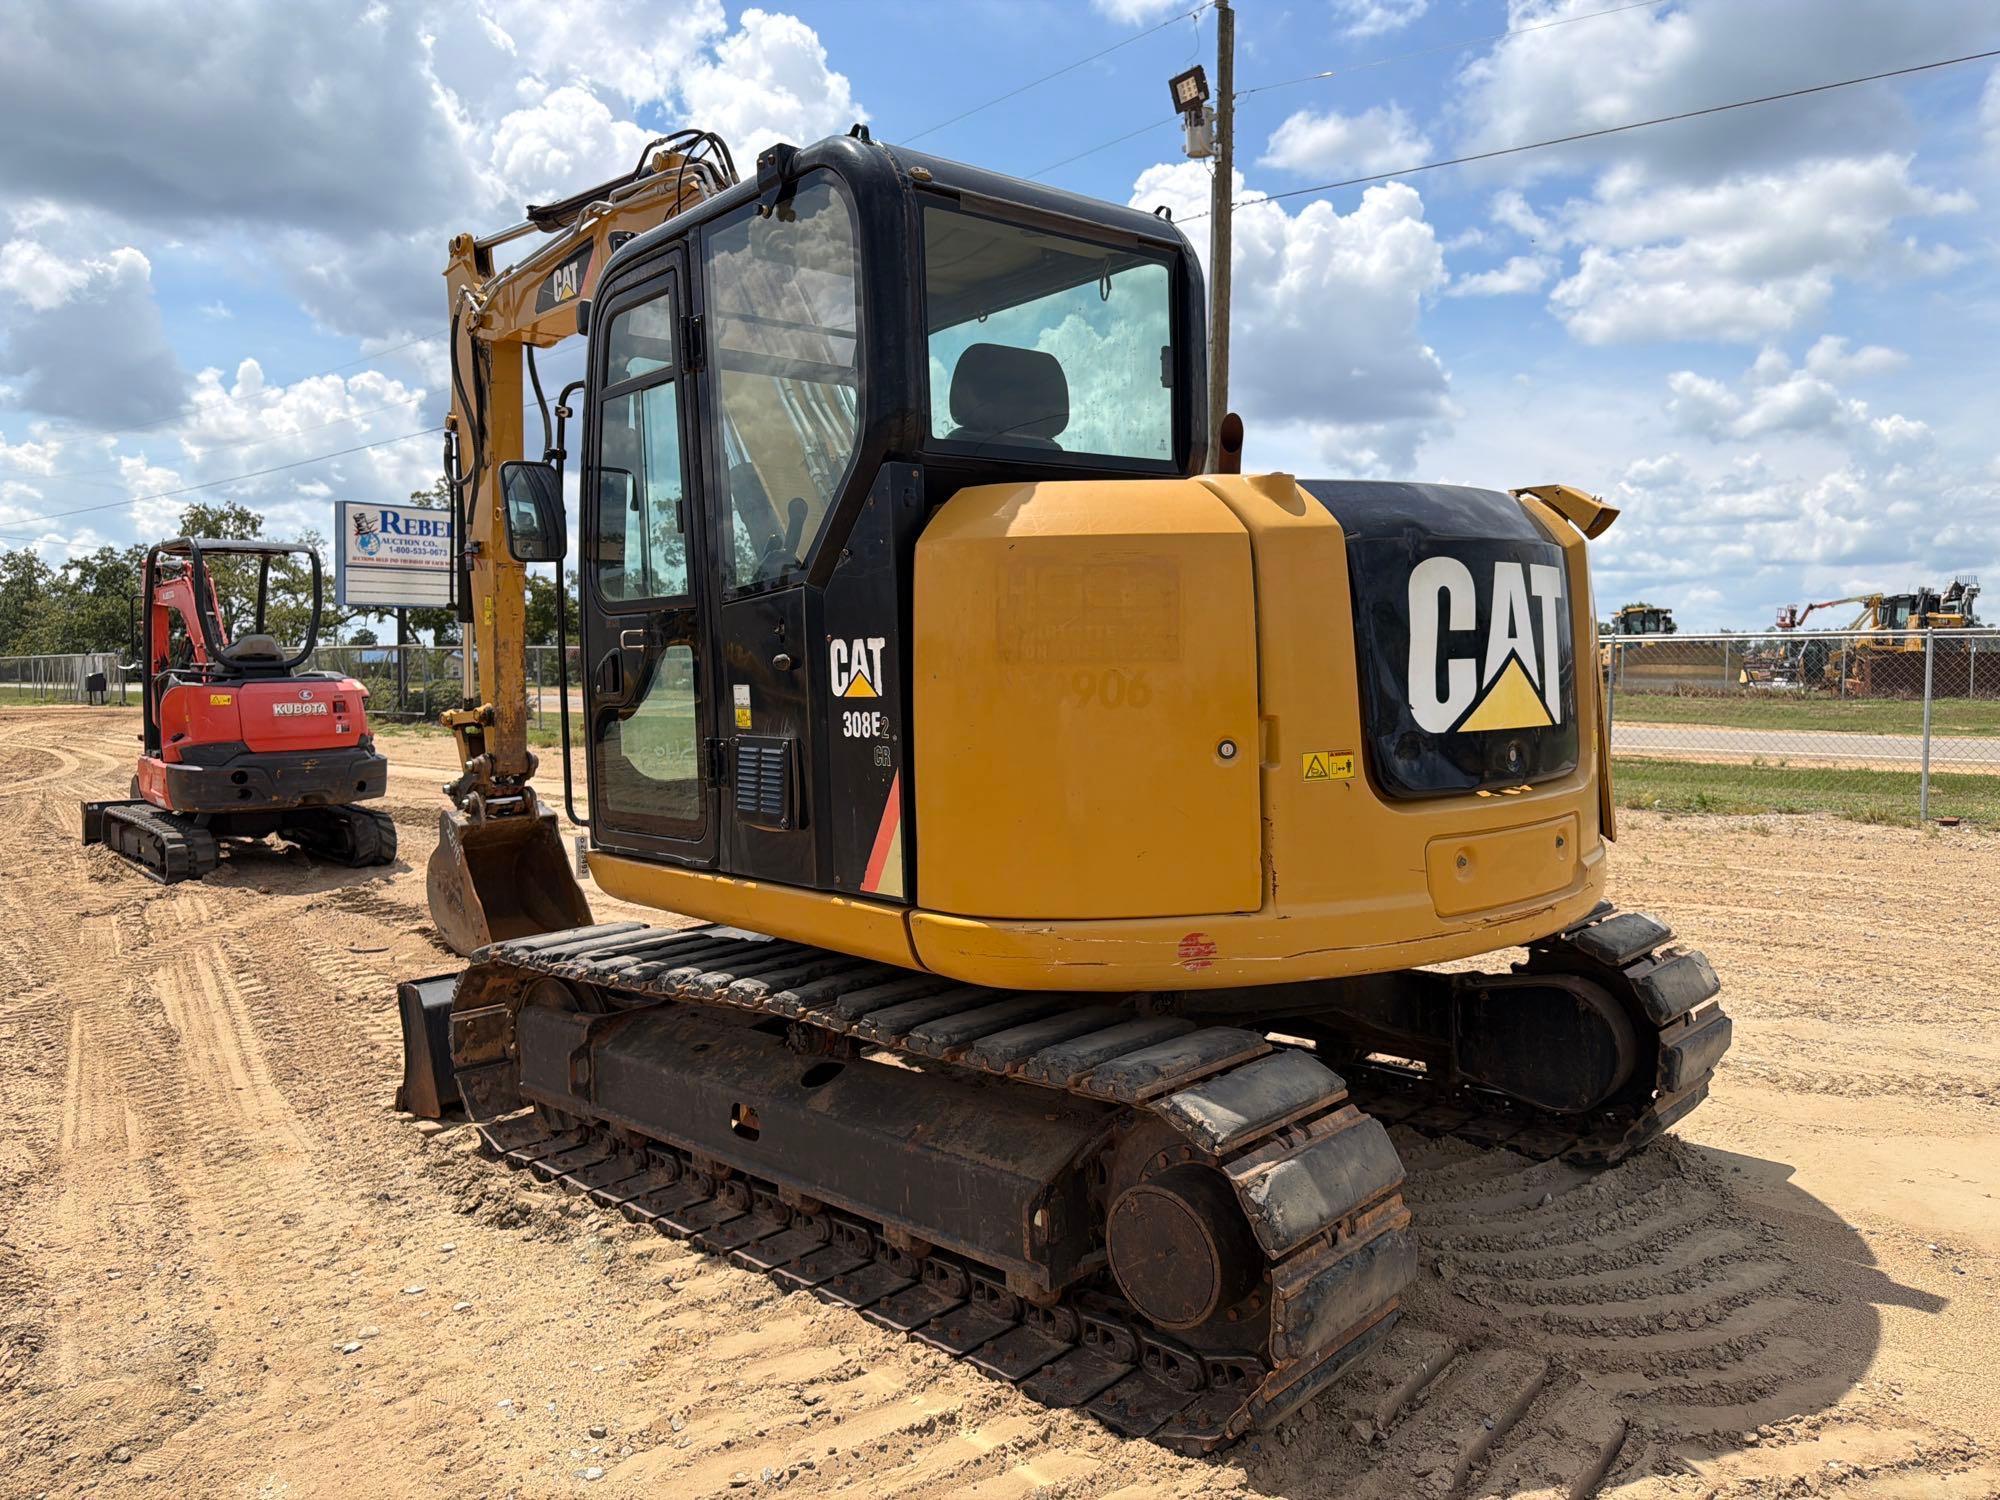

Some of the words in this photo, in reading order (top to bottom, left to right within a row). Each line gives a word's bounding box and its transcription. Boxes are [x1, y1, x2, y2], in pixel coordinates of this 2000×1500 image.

[553, 261, 578, 302] CAT
[381, 538, 420, 547] AUCTION
[1408, 556, 1562, 734] CAT
[830, 637, 885, 697] CAT
[272, 702, 328, 716] KUBOTA
[1071, 669, 1153, 709] 906
